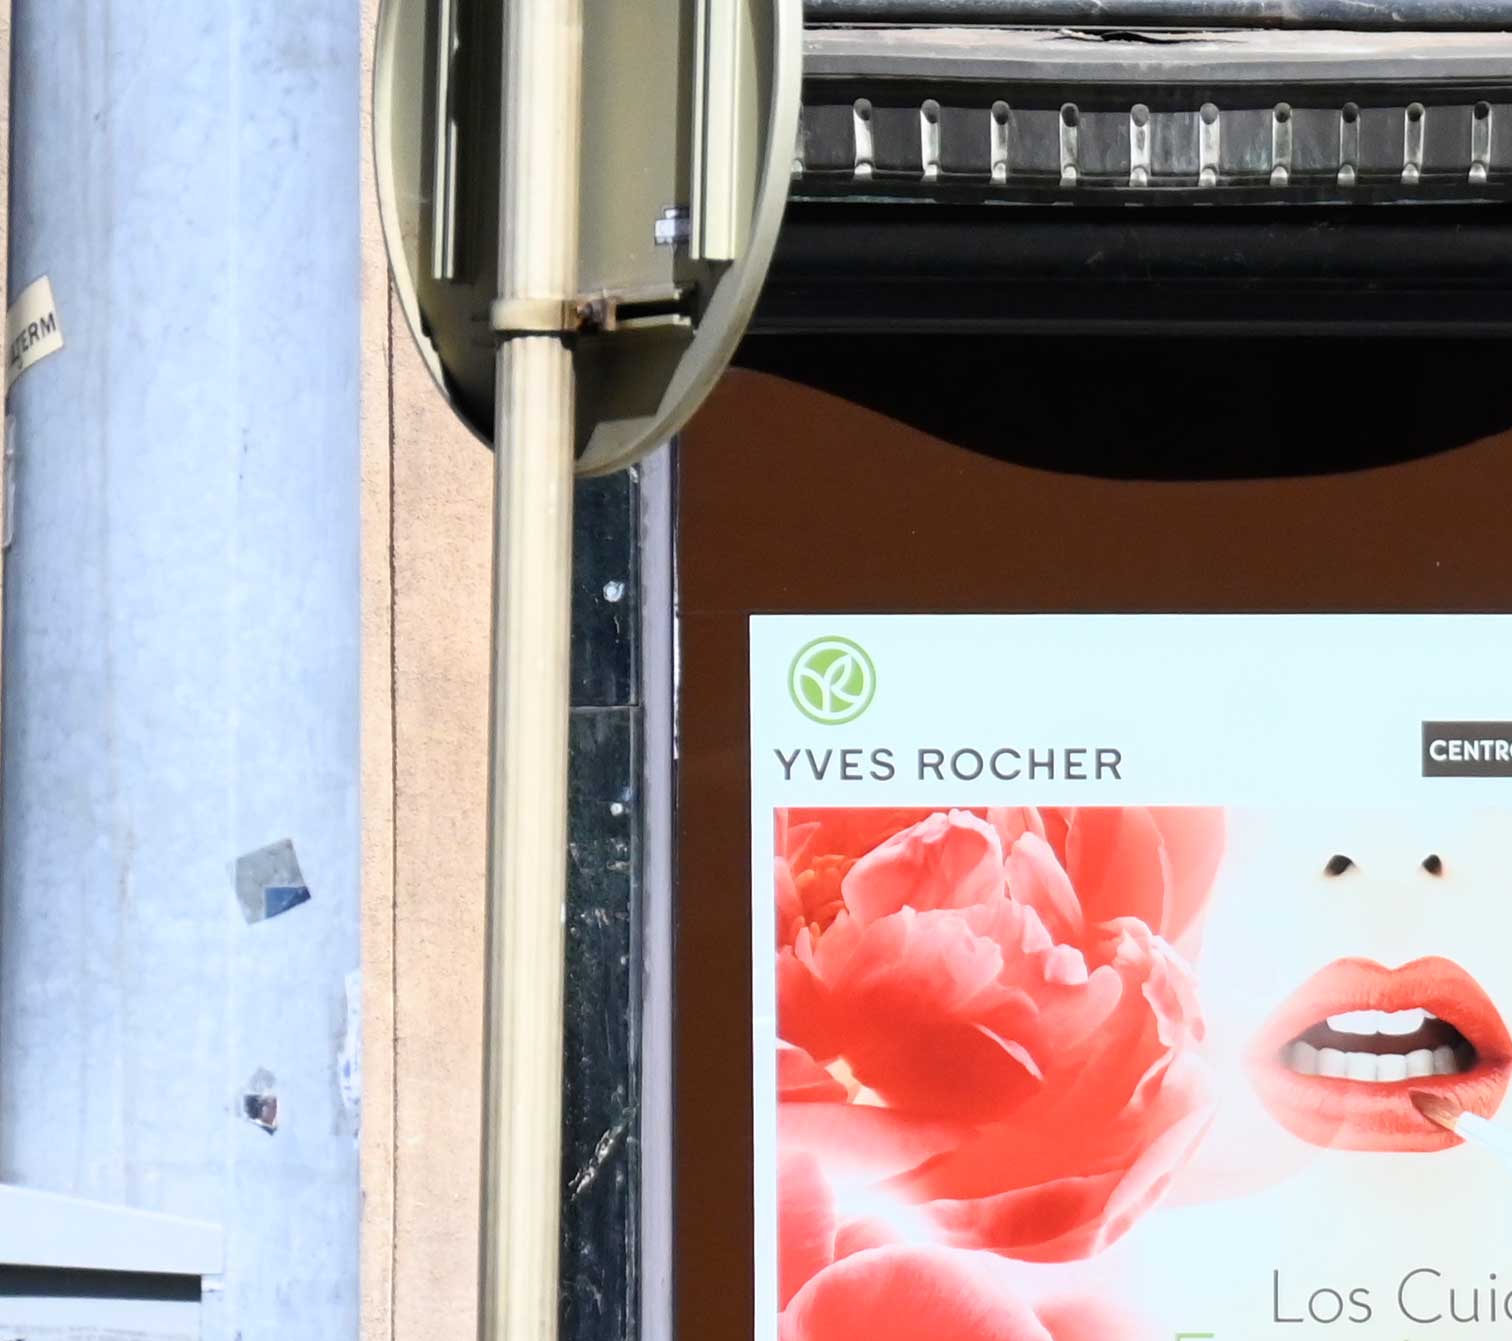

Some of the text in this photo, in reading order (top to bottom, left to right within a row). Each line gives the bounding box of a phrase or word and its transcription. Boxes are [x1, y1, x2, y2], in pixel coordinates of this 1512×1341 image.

[774, 748, 1121, 781] YVES ROCHER
[1274, 1270, 1372, 1323] Los
